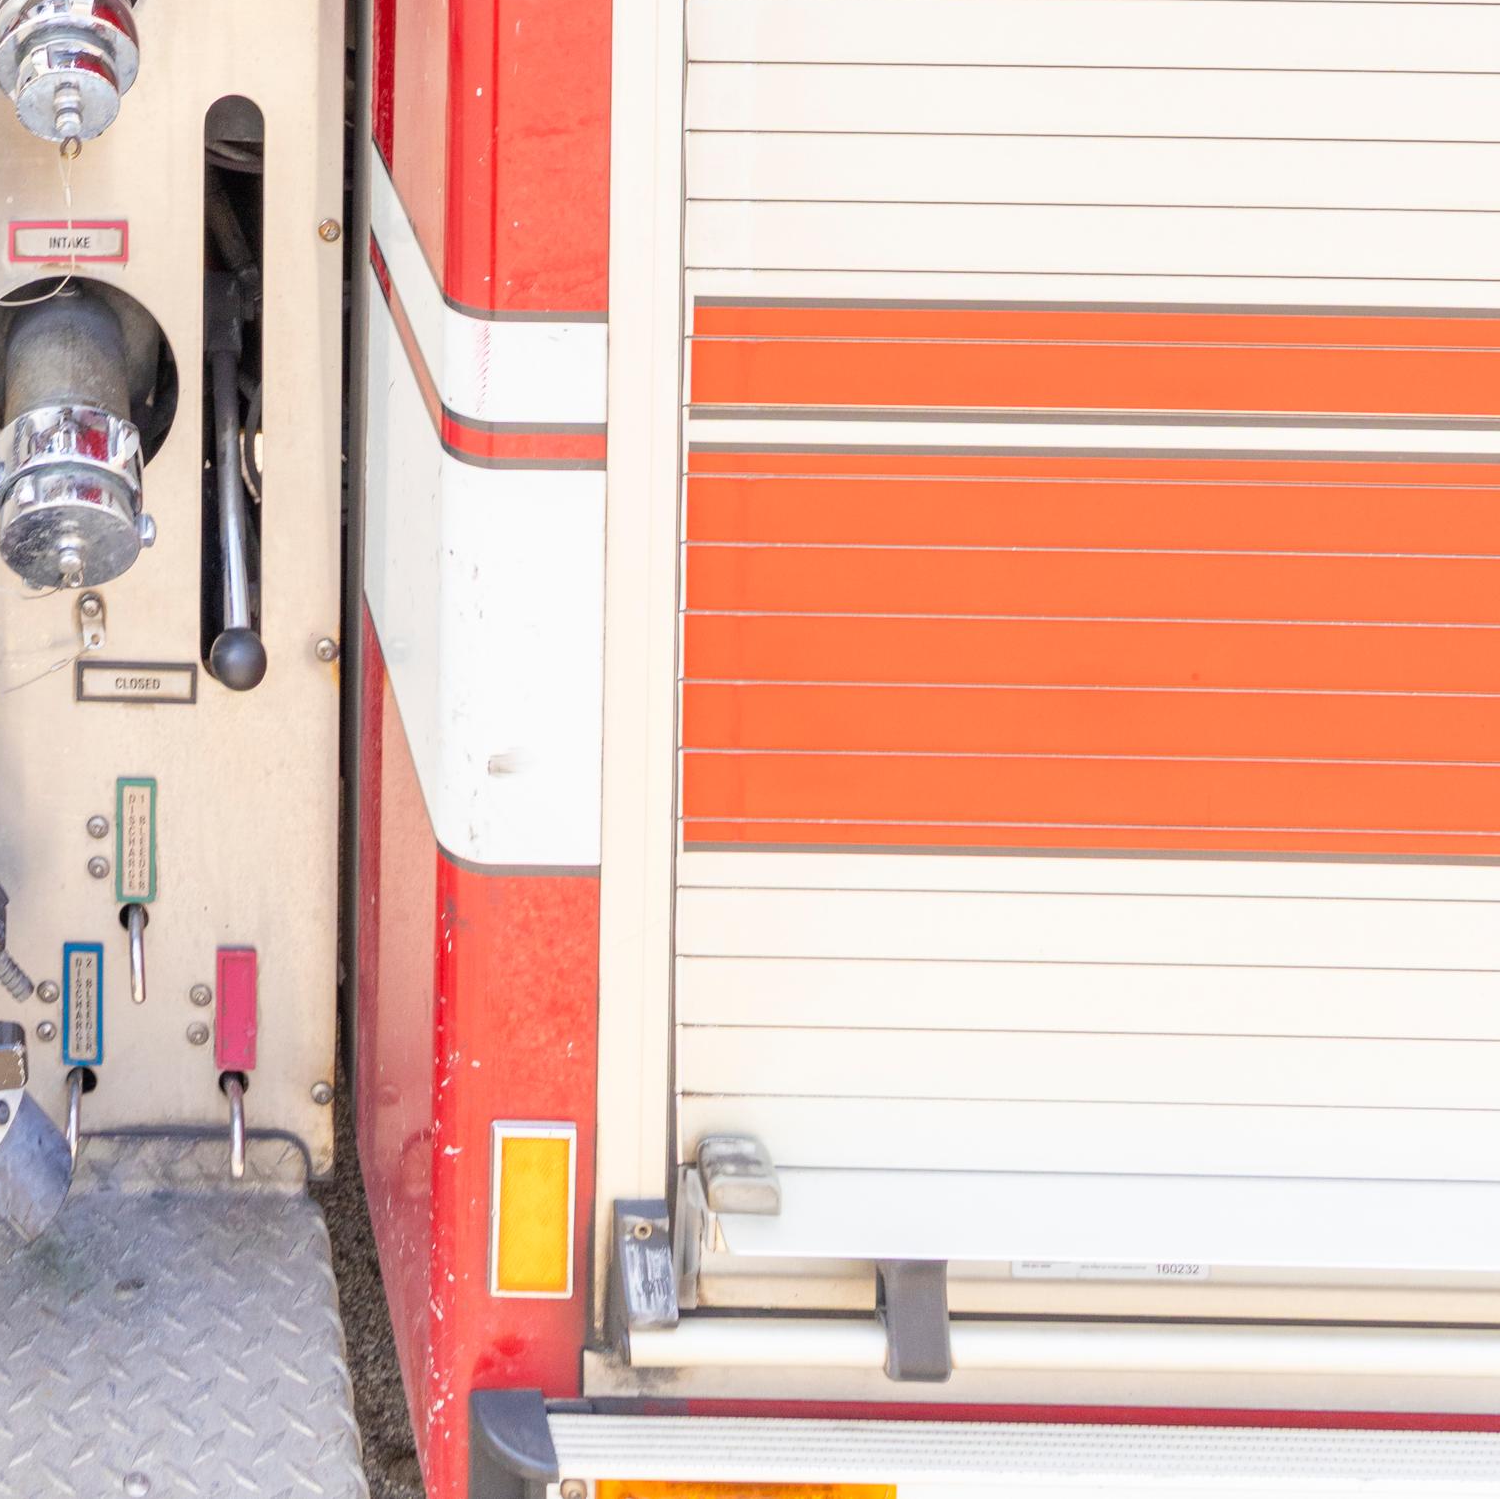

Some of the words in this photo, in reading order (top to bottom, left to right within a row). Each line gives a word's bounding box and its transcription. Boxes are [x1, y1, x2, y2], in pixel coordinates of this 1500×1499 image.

[49, 236, 91, 249] INTAKE
[115, 677, 161, 690] CLOSED
[1156, 1263, 1200, 1275] 160232
